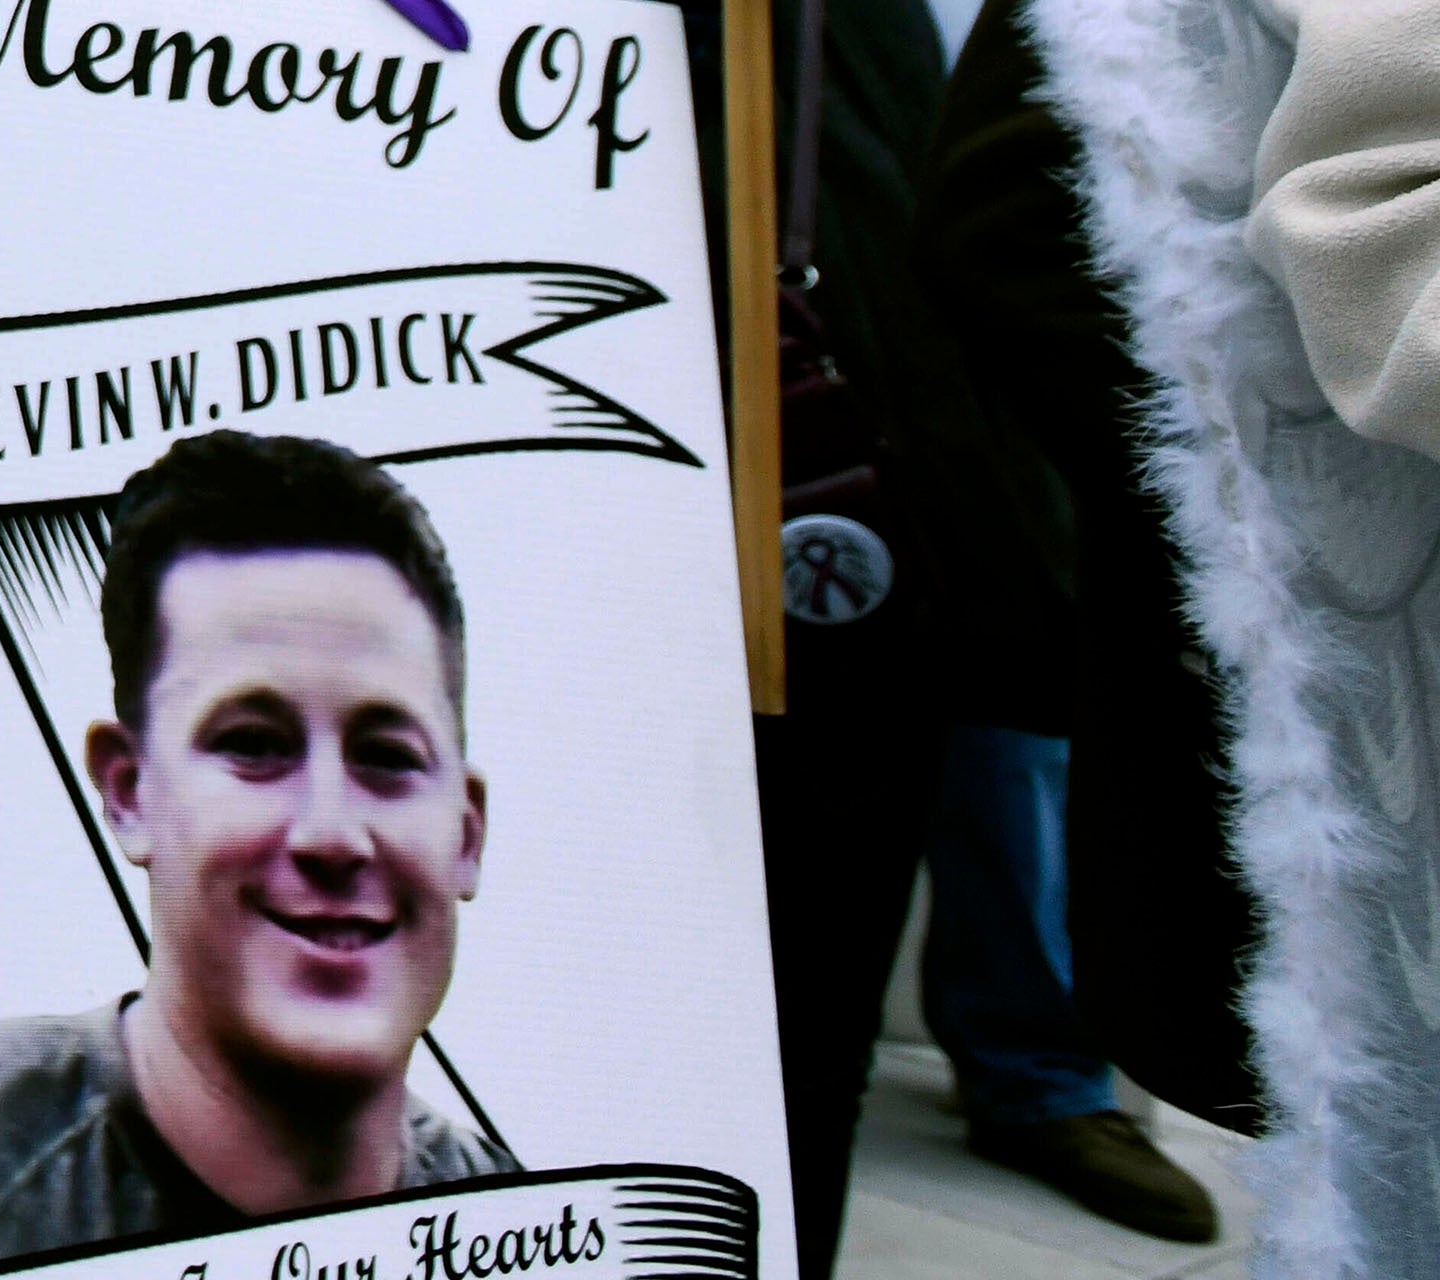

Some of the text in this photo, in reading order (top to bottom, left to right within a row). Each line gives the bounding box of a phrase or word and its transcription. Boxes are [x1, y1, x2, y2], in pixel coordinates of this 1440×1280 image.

[496, 23, 652, 191] Of
[237, 311, 488, 416] DIDICK
[407, 1203, 606, 1280] Hearts
